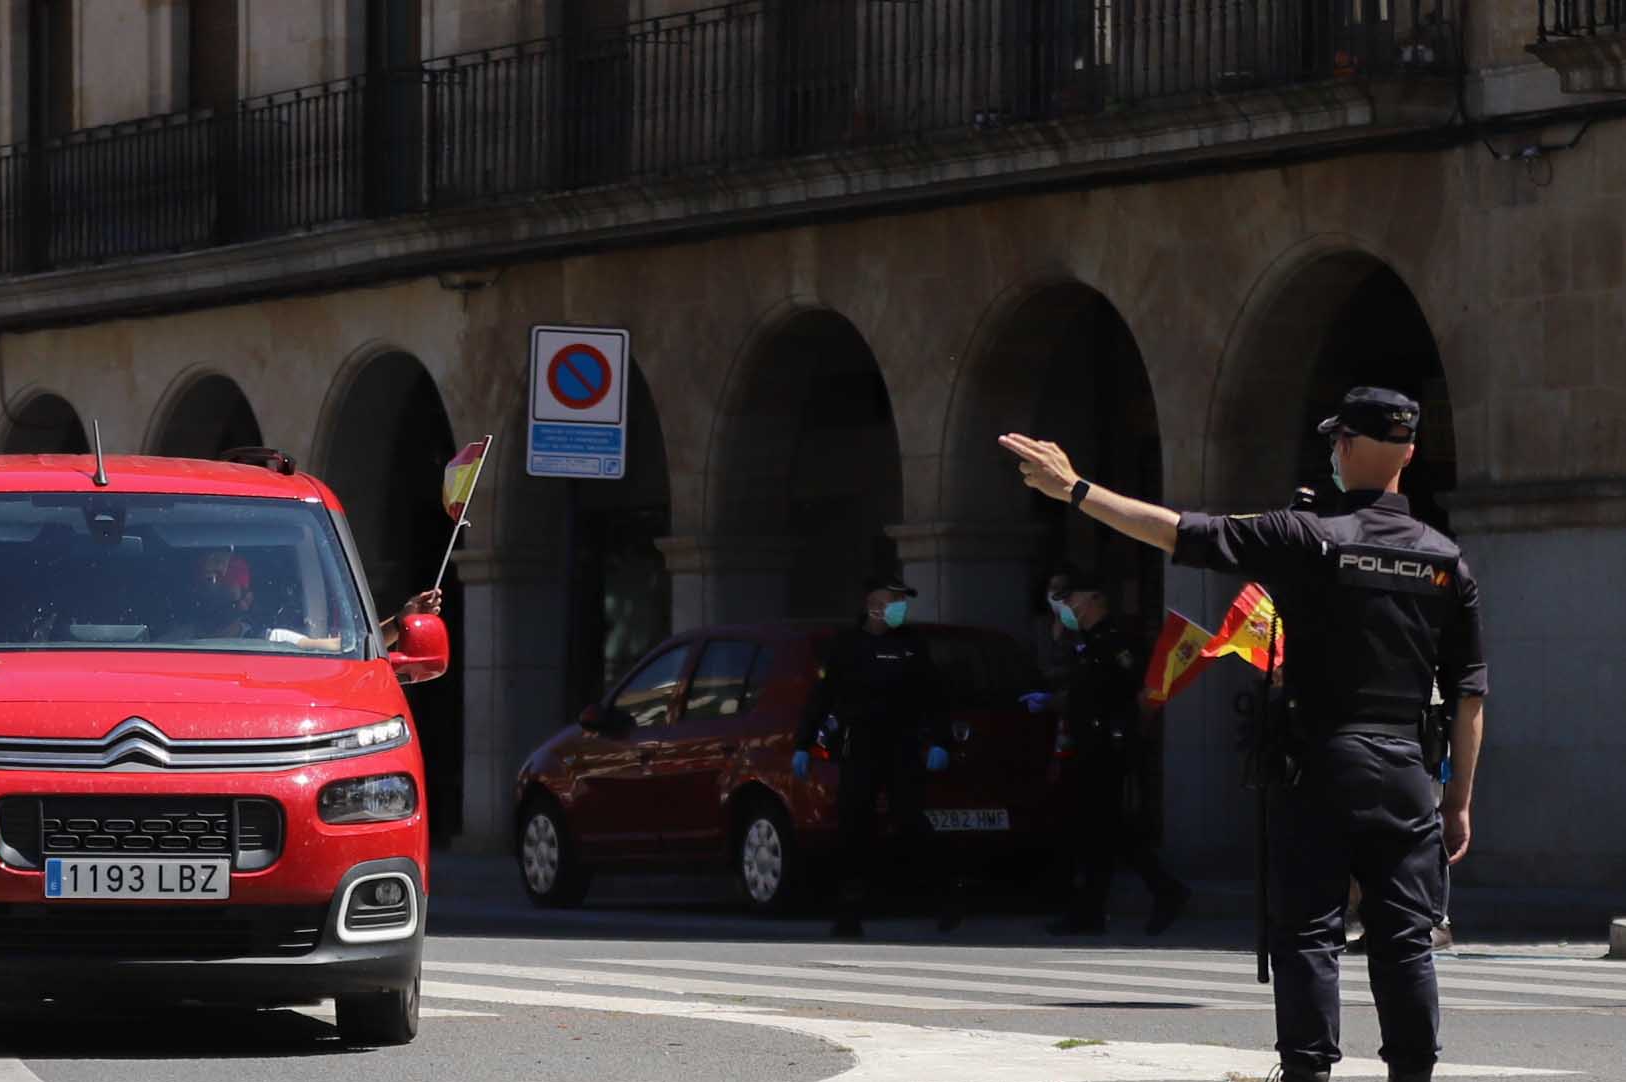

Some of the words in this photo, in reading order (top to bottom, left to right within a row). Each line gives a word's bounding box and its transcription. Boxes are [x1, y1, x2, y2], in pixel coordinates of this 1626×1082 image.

[1340, 554, 1436, 578] POLICIA
[69, 864, 145, 892] 1193
[158, 864, 218, 893] LBZ
